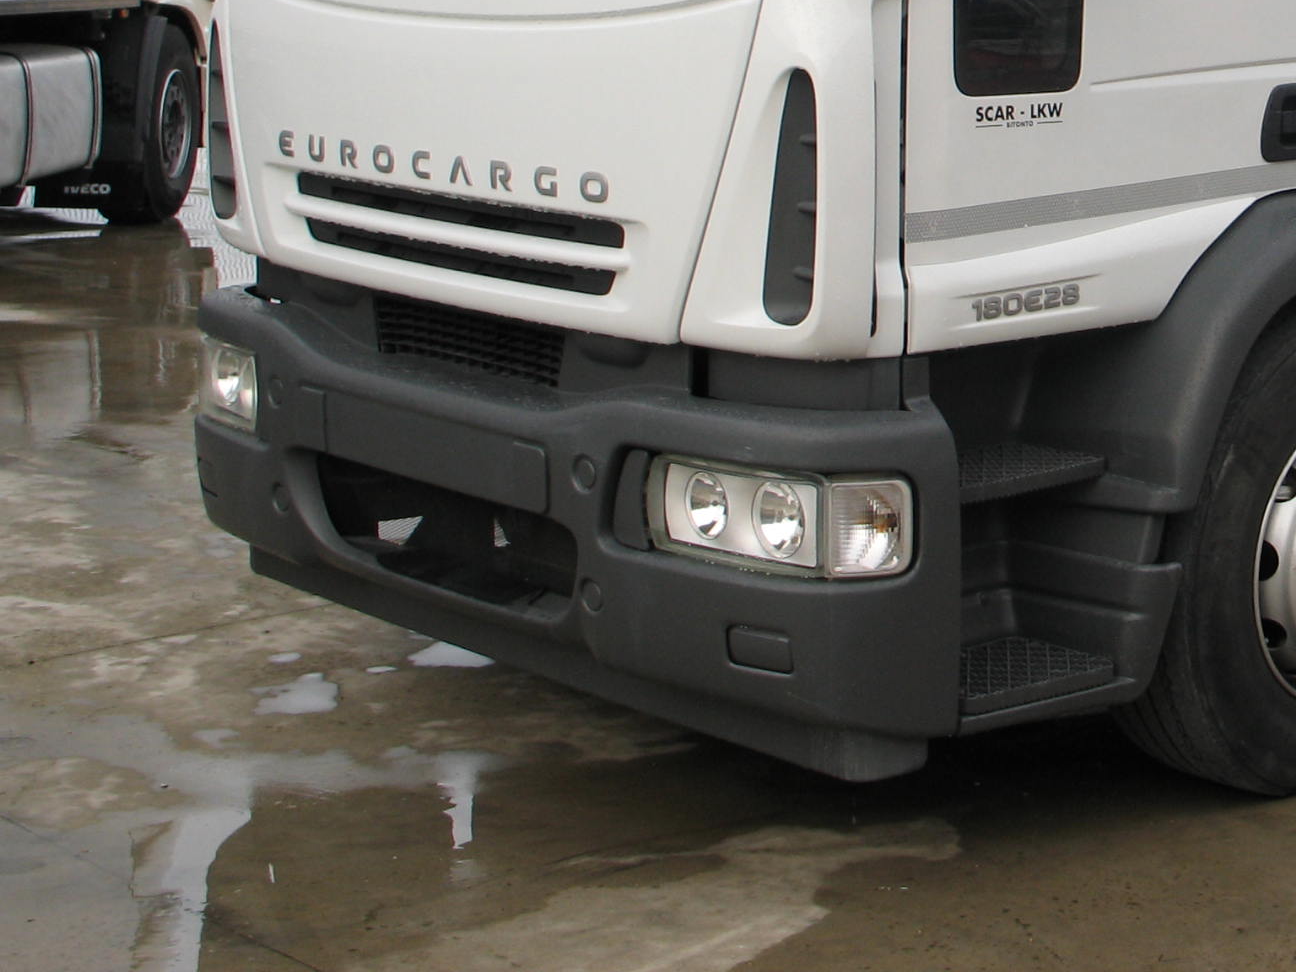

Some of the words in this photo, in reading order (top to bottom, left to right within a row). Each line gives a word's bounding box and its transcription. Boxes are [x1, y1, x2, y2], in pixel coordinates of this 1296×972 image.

[976, 105, 1015, 122] SCAR
[1030, 102, 1063, 119] LKW
[1006, 120, 1034, 129] BITONTO
[278, 129, 610, 204] EUROCARGO
[63, 183, 112, 195] IVECO
[971, 283, 1080, 323] 180E28
